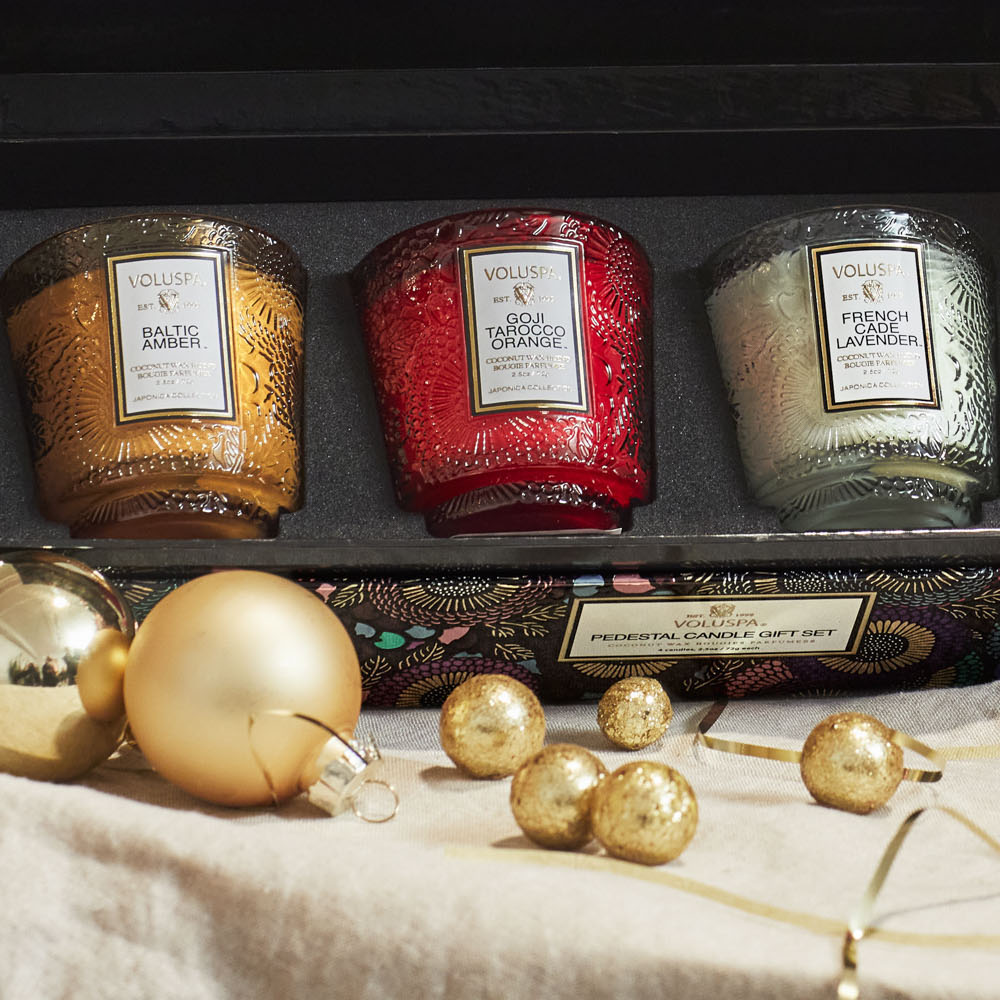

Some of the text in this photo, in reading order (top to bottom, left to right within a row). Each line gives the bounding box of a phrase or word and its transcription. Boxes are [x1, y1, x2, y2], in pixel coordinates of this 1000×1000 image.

[484, 266, 559, 281] VOLUSPA
[832, 263, 904, 279] VOLUSPA
[506, 312, 545, 325] GOJI
[842, 310, 909, 324] FRENCH
[142, 325, 200, 339] BALTIC
[485, 325, 566, 339] TAROCCO
[854, 322, 900, 335] CADE
[142, 337, 201, 351] AMBER
[491, 337, 563, 350] ORANGE
[836, 334, 918, 349] LAVENDER
[674, 618, 758, 629] VOLUSPA
[591, 629, 838, 642] PEDESTAL CANDLE GIFT SET
